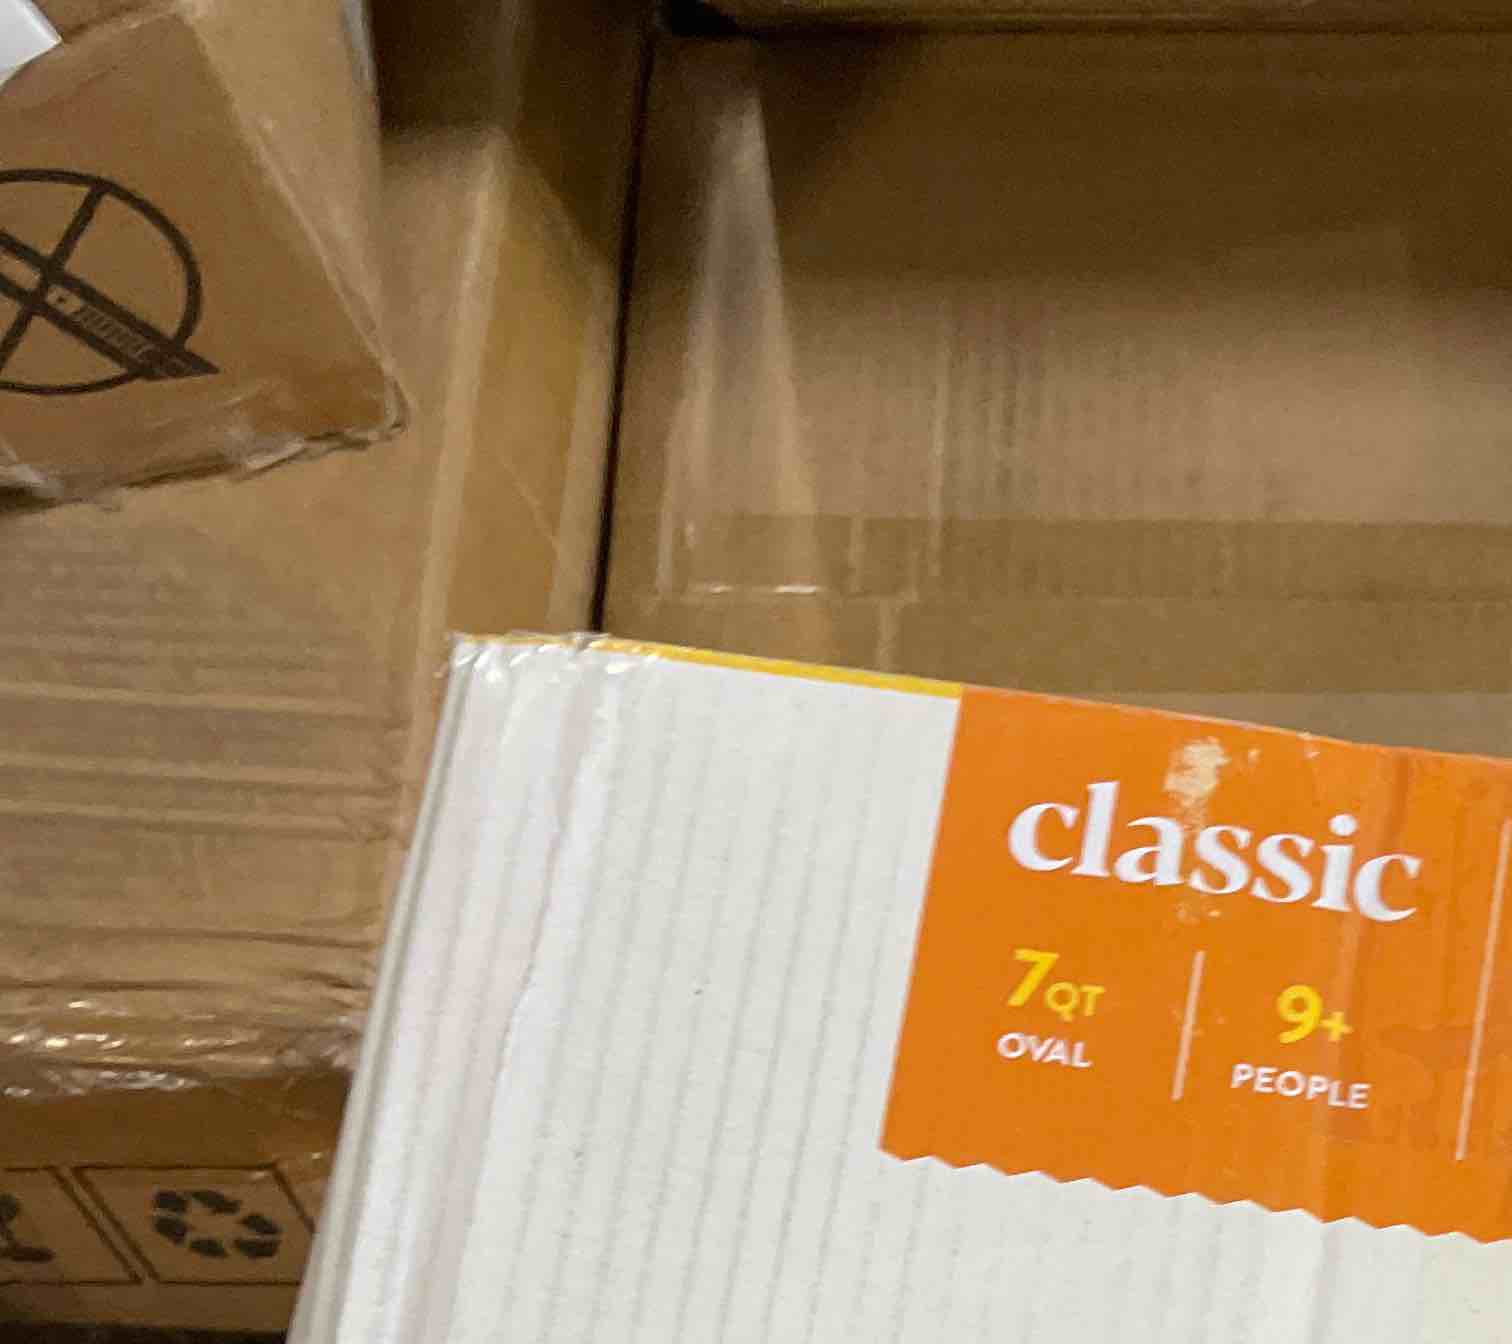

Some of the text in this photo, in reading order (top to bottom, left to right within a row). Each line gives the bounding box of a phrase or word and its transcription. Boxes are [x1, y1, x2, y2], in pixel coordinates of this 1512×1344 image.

[1007, 780, 1424, 922] classic
[1276, 983, 1353, 1045] 9+
[996, 1031, 1094, 1068] OVAL
[1229, 1063, 1372, 1111] PEOPLE
